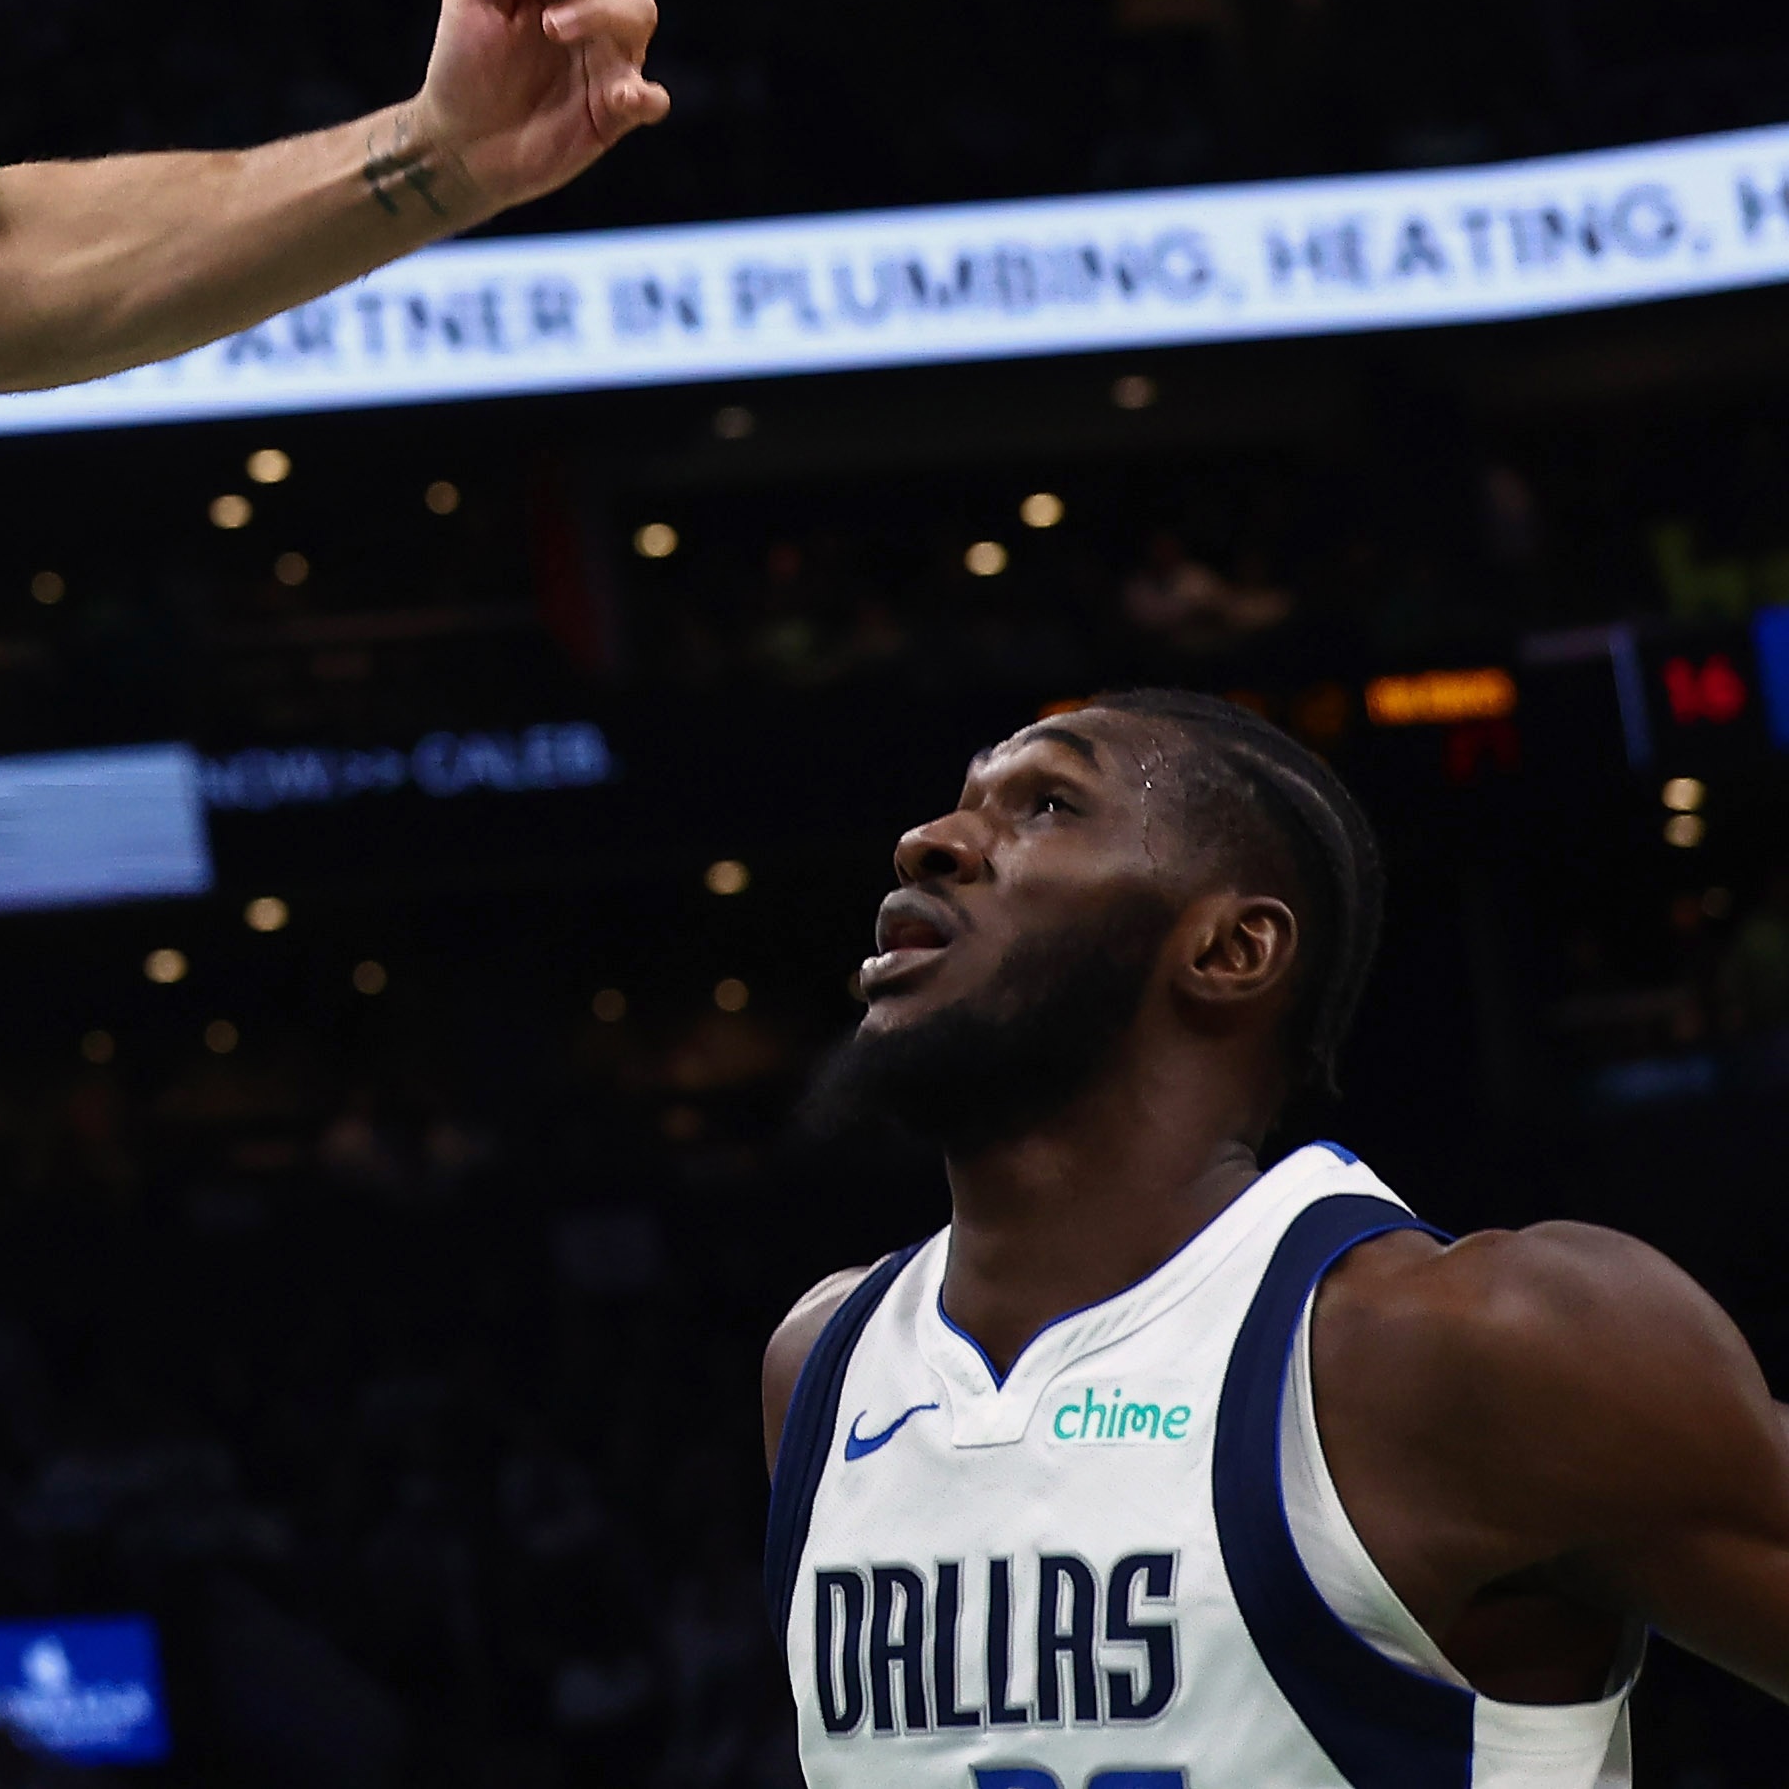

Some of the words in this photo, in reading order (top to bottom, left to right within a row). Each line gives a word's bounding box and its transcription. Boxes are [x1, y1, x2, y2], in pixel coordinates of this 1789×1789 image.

[611, 270, 703, 334] IN
[1054, 1387, 1191, 1442] chime
[813, 1548, 1183, 1738] DALLAS
